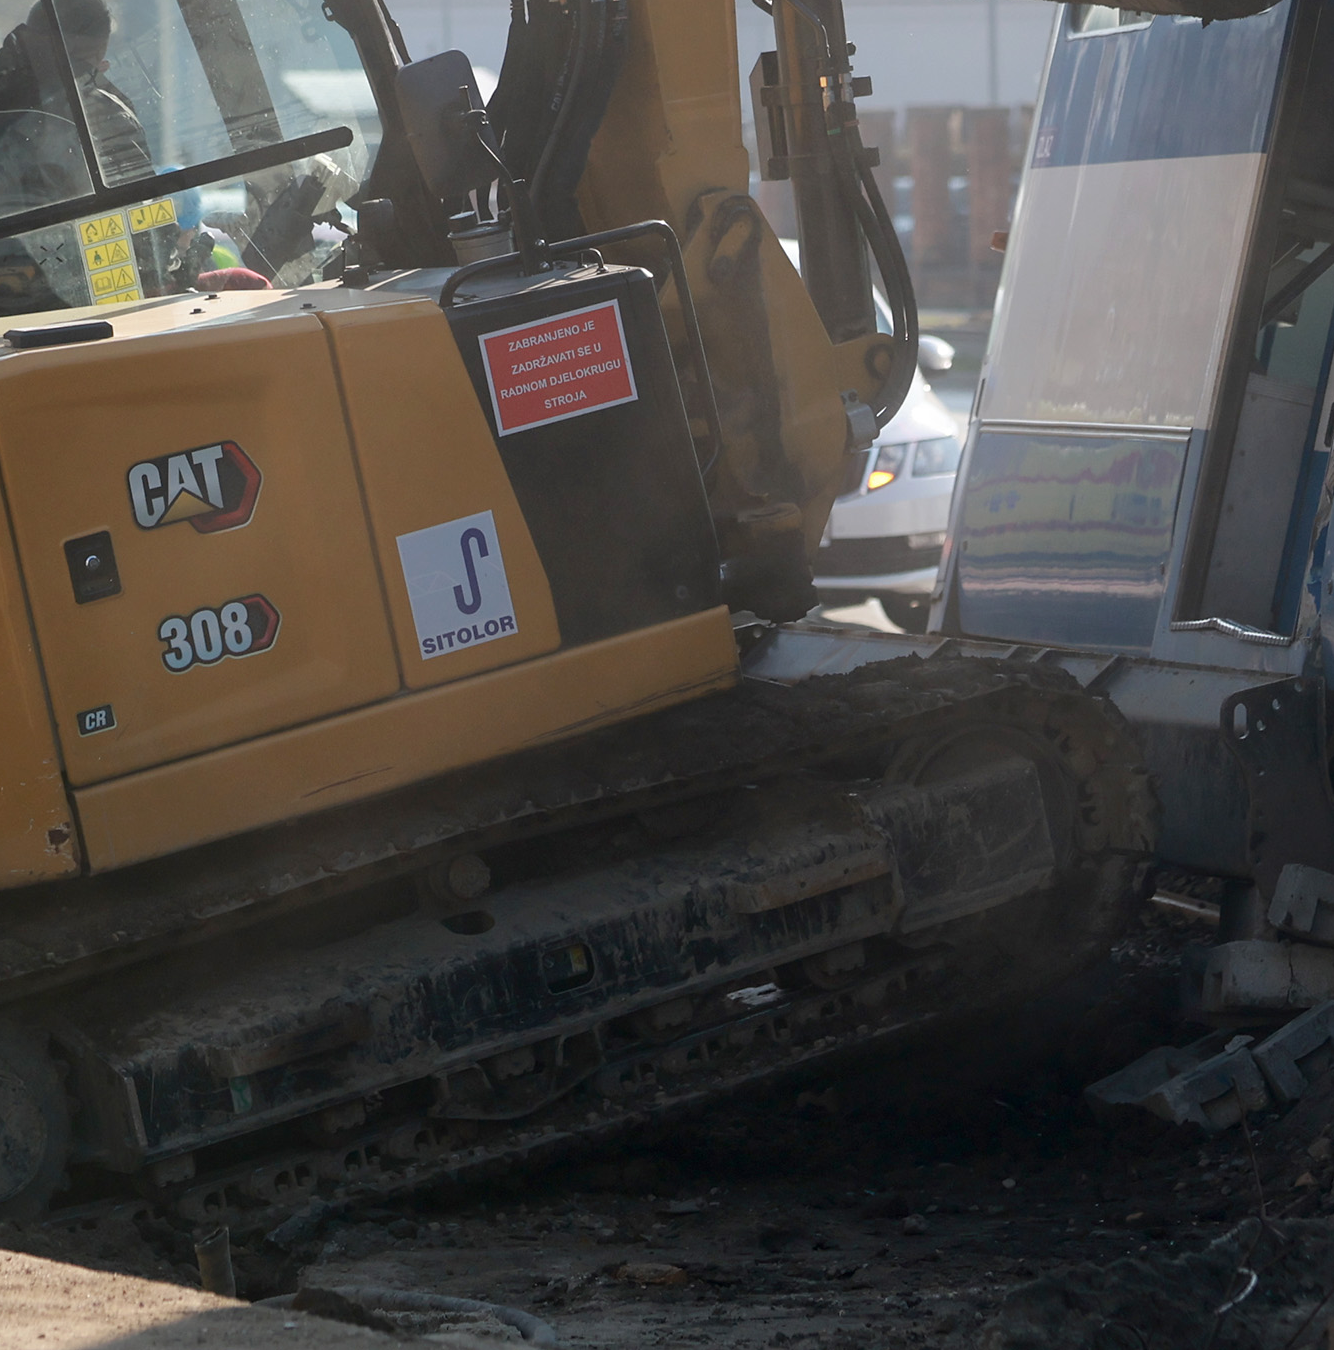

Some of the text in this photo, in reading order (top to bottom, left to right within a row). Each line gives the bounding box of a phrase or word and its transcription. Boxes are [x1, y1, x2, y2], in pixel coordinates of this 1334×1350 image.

[508, 320, 596, 352] ZABRANJENO JE
[511, 342, 602, 375] ZADRŽAVATI SE U
[500, 358, 622, 400] RADNOM DJELOKRUGU
[544, 389, 587, 410] STROJA
[127, 444, 224, 529] CAT
[160, 602, 250, 669] 308
[421, 615, 515, 656] SITOLOR
[84, 710, 107, 730] CR
